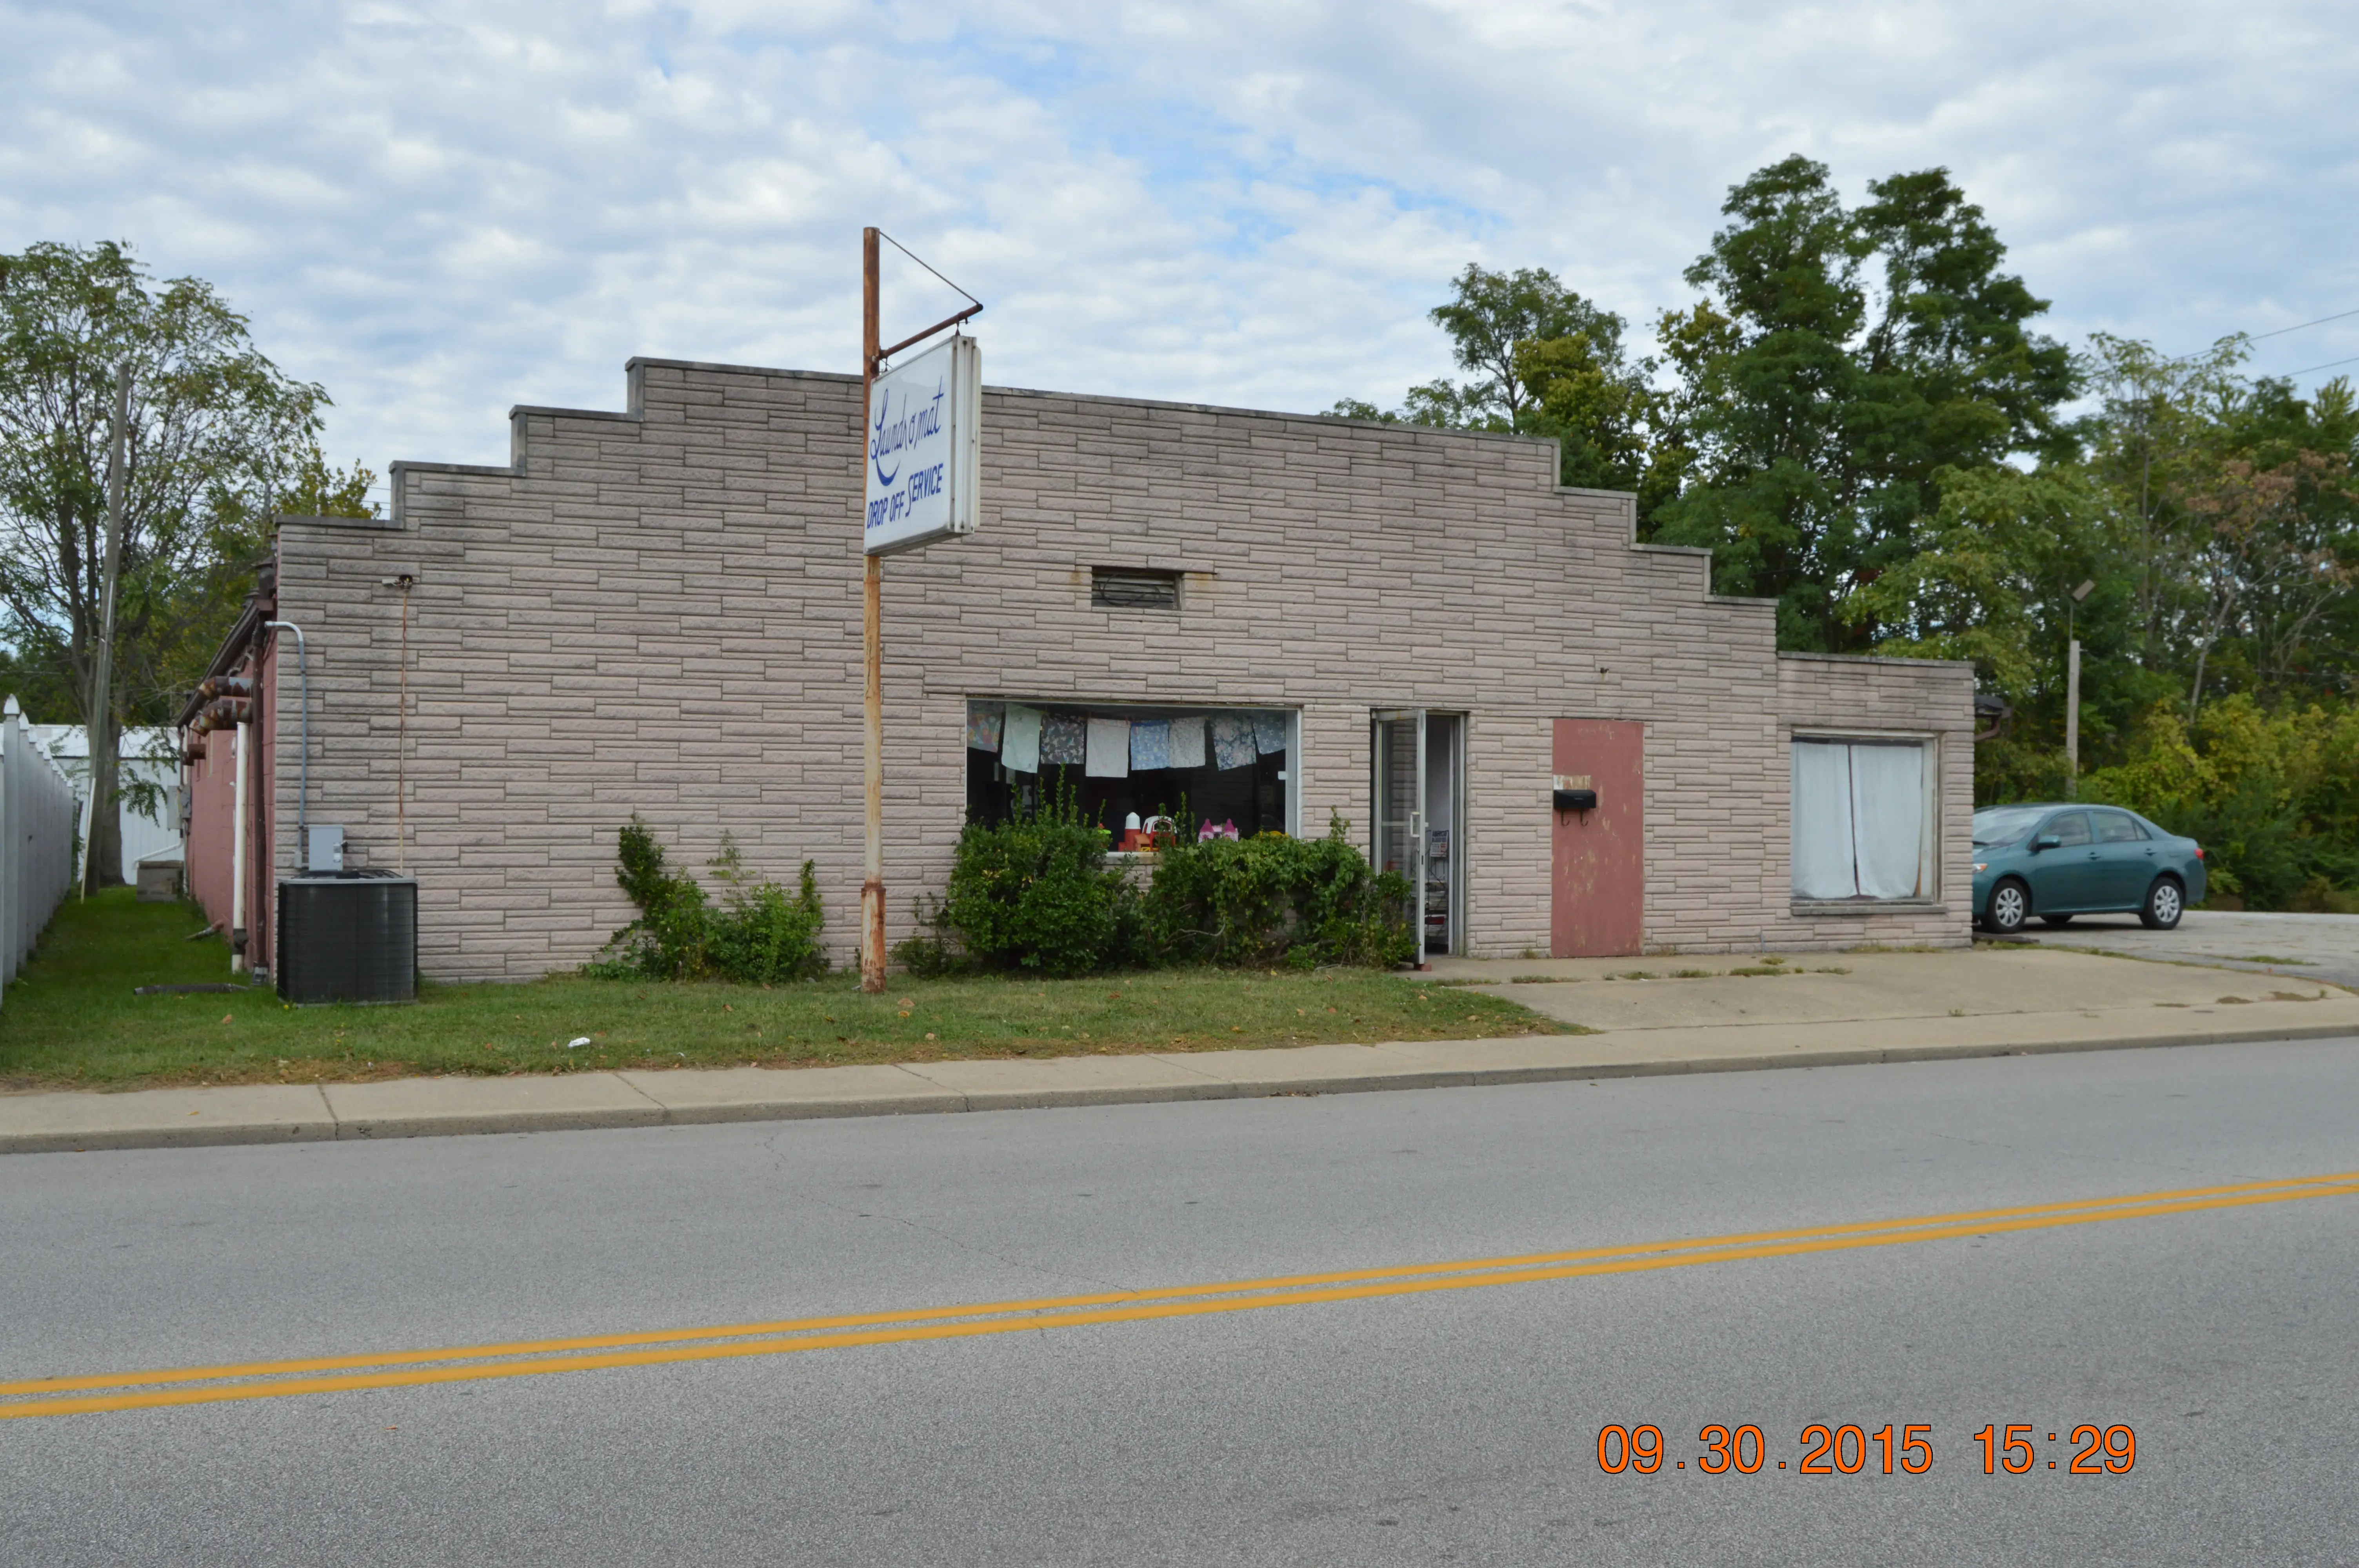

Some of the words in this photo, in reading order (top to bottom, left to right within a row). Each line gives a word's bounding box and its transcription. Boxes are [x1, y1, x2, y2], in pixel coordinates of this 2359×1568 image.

[867, 497, 888, 529] DROP
[889, 490, 905, 522] OFF
[905, 463, 943, 517] SERVICE
